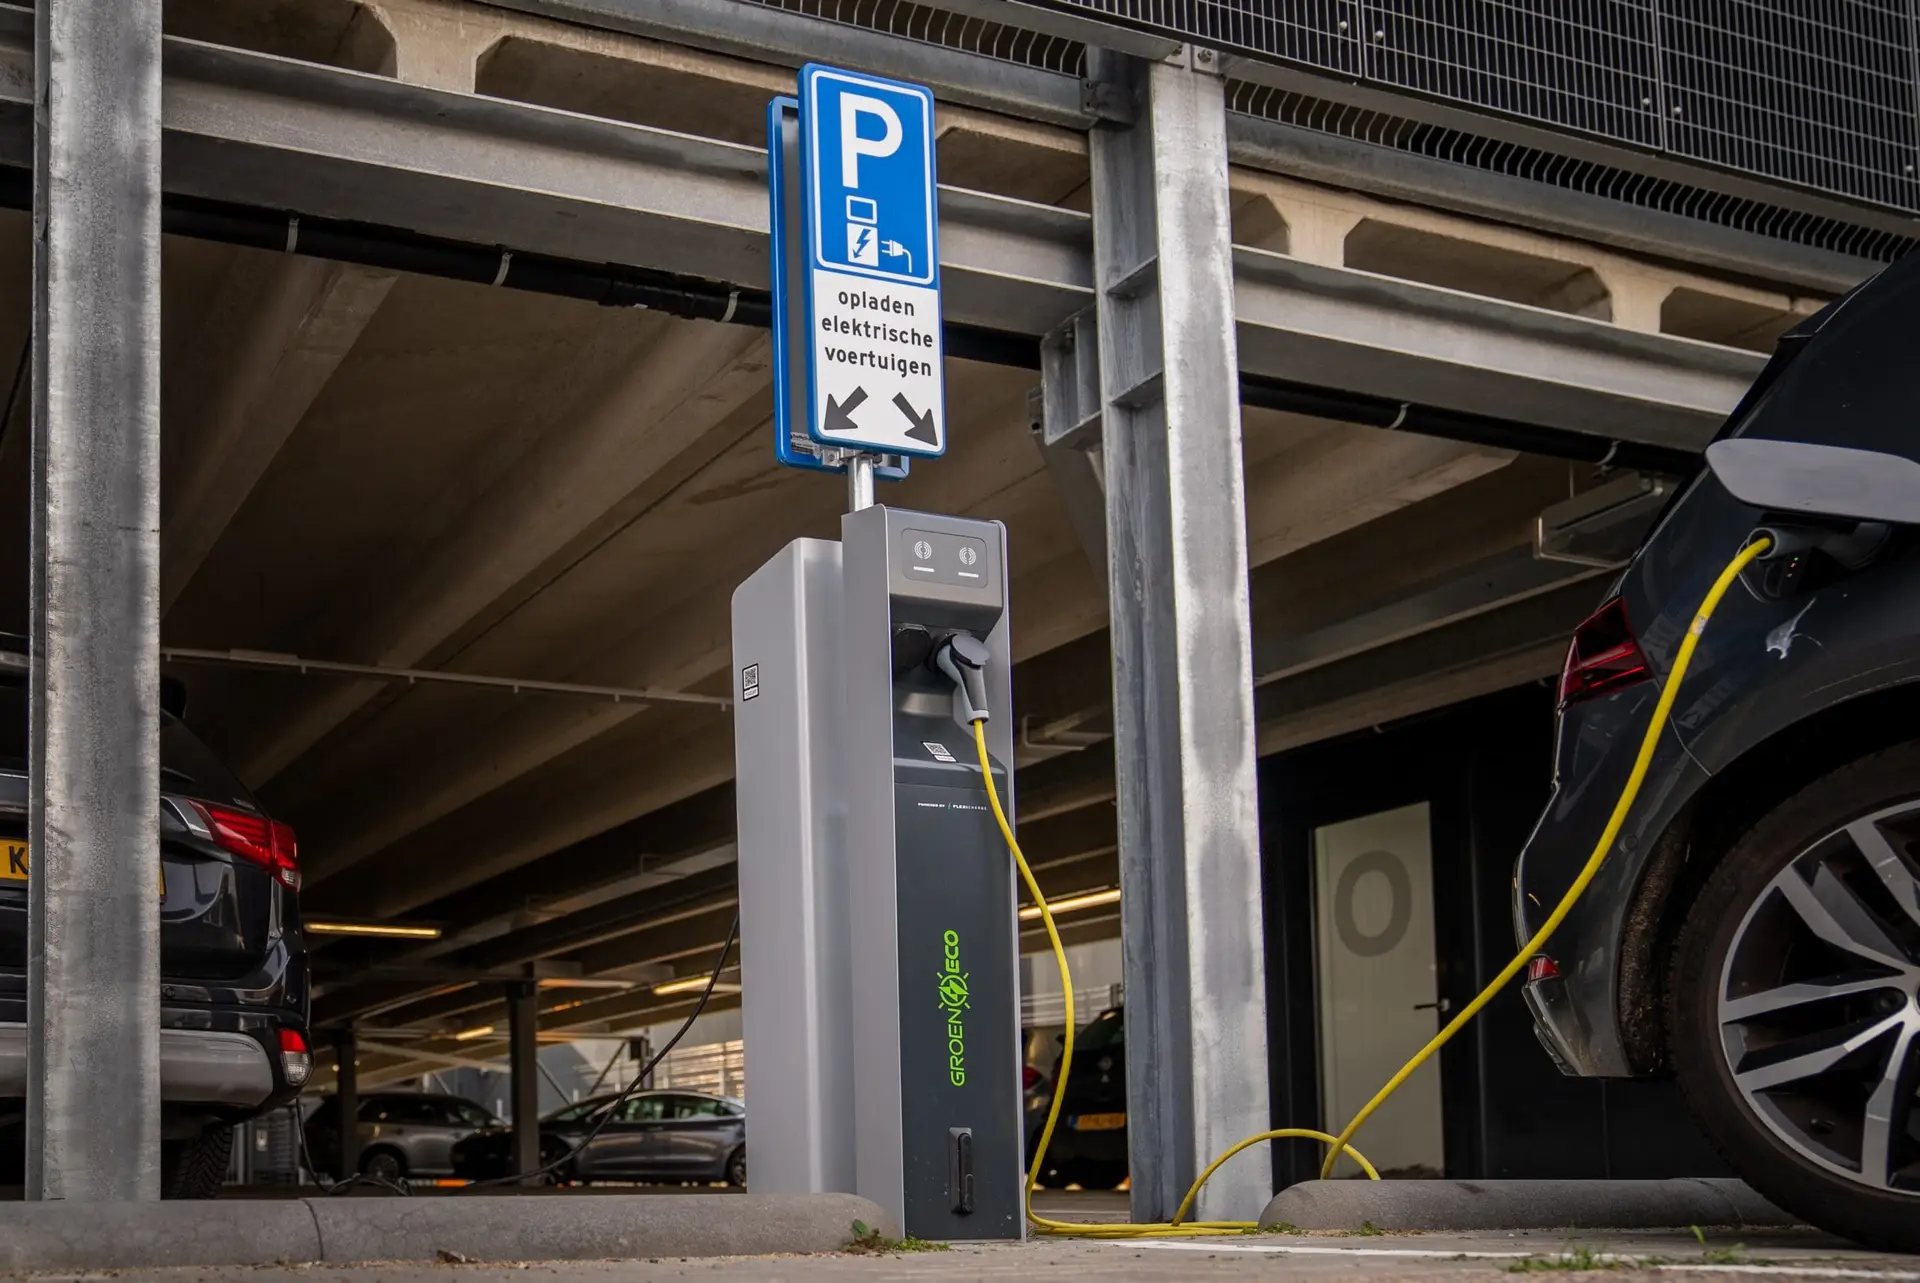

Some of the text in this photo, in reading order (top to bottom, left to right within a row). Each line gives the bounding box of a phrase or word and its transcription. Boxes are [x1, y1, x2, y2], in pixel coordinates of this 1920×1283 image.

[840, 91, 903, 189] P
[838, 291, 915, 316] opladen
[821, 315, 933, 348] elektrische
[824, 346, 931, 378] voertuigen
[943, 929, 966, 1086] GROEN ECO
